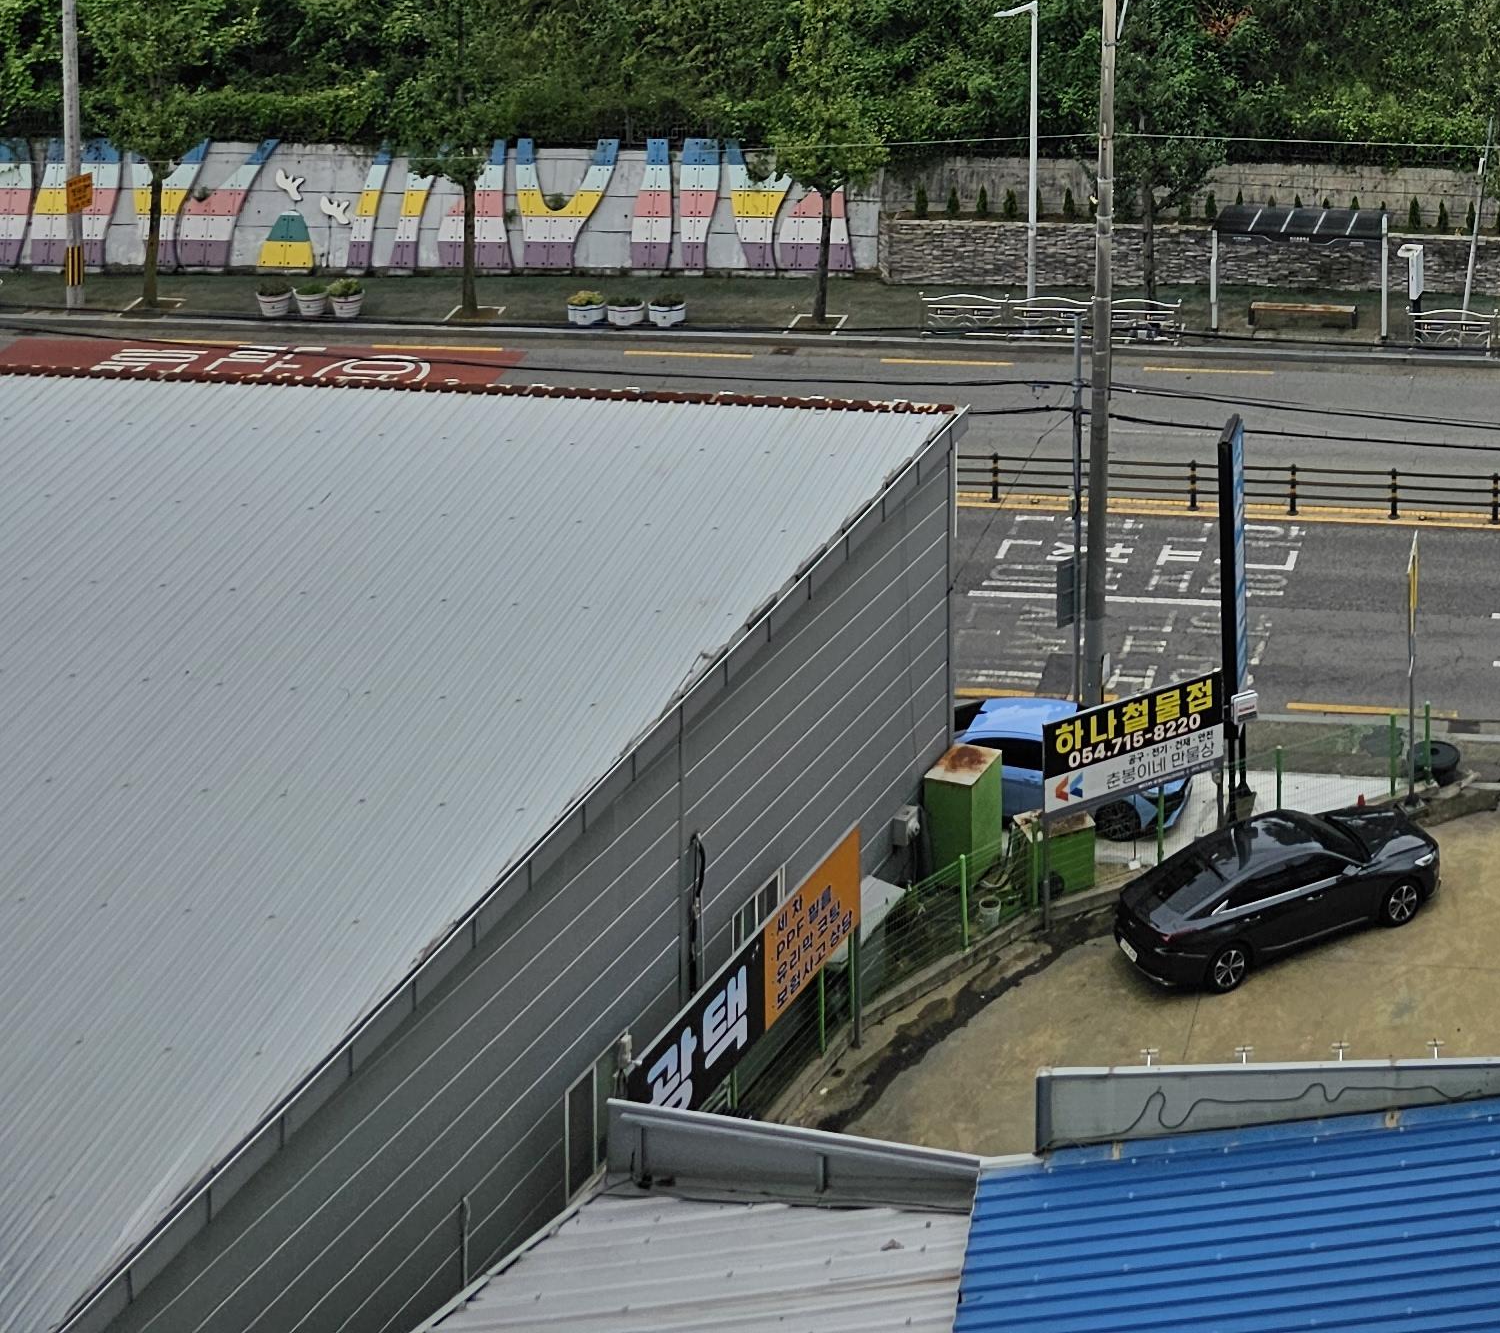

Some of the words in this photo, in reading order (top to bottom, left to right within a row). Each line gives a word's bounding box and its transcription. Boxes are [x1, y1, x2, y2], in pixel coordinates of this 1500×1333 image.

[1055, 679, 1213, 754] 하나철물점
[1068, 713, 1201, 768] 054.715-8220
[1128, 752, 1145, 765] 공구
[1152, 744, 1168, 758] 전기
[1171, 740, 1215, 769] 만물상
[776, 916, 804, 961] PPF
[776, 930, 813, 984] 유리막
[817, 900, 841, 939] 코팅
[776, 940, 826, 1010] 보험사고
[830, 910, 853, 948] 상담
[647, 965, 748, 1111] 광택
